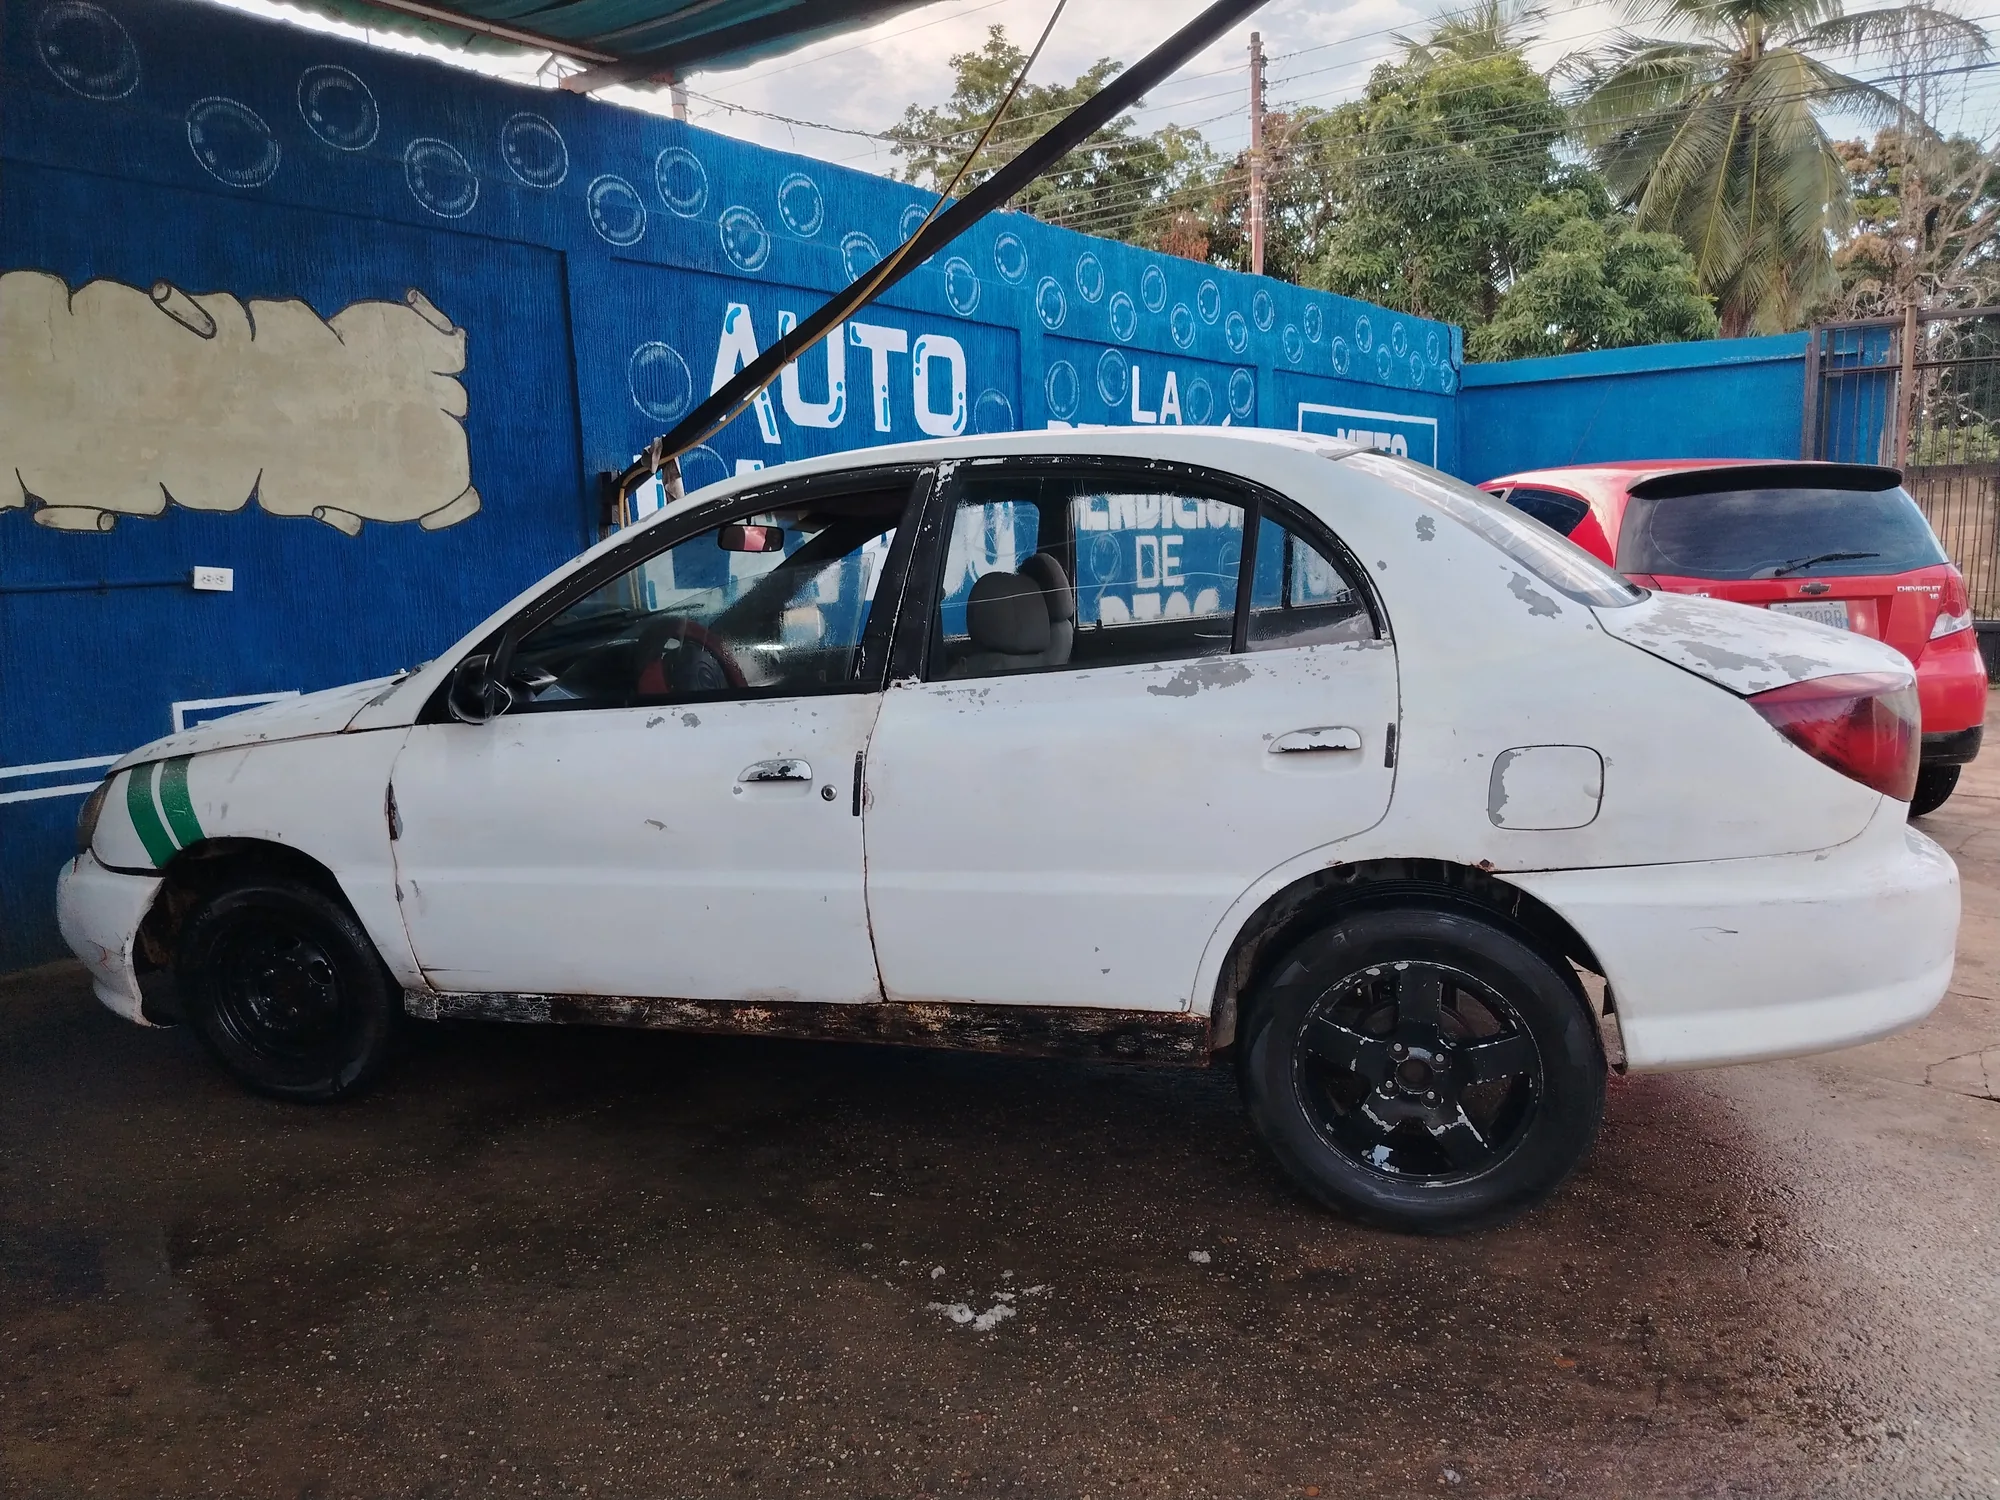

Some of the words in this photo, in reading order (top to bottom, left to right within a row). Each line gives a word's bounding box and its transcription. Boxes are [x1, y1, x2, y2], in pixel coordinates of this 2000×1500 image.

[710, 302, 967, 444] AUTO
[1131, 365, 1183, 425] LA
[1135, 534, 1185, 588] DE
[1896, 585, 1942, 593] CHEVROLET
